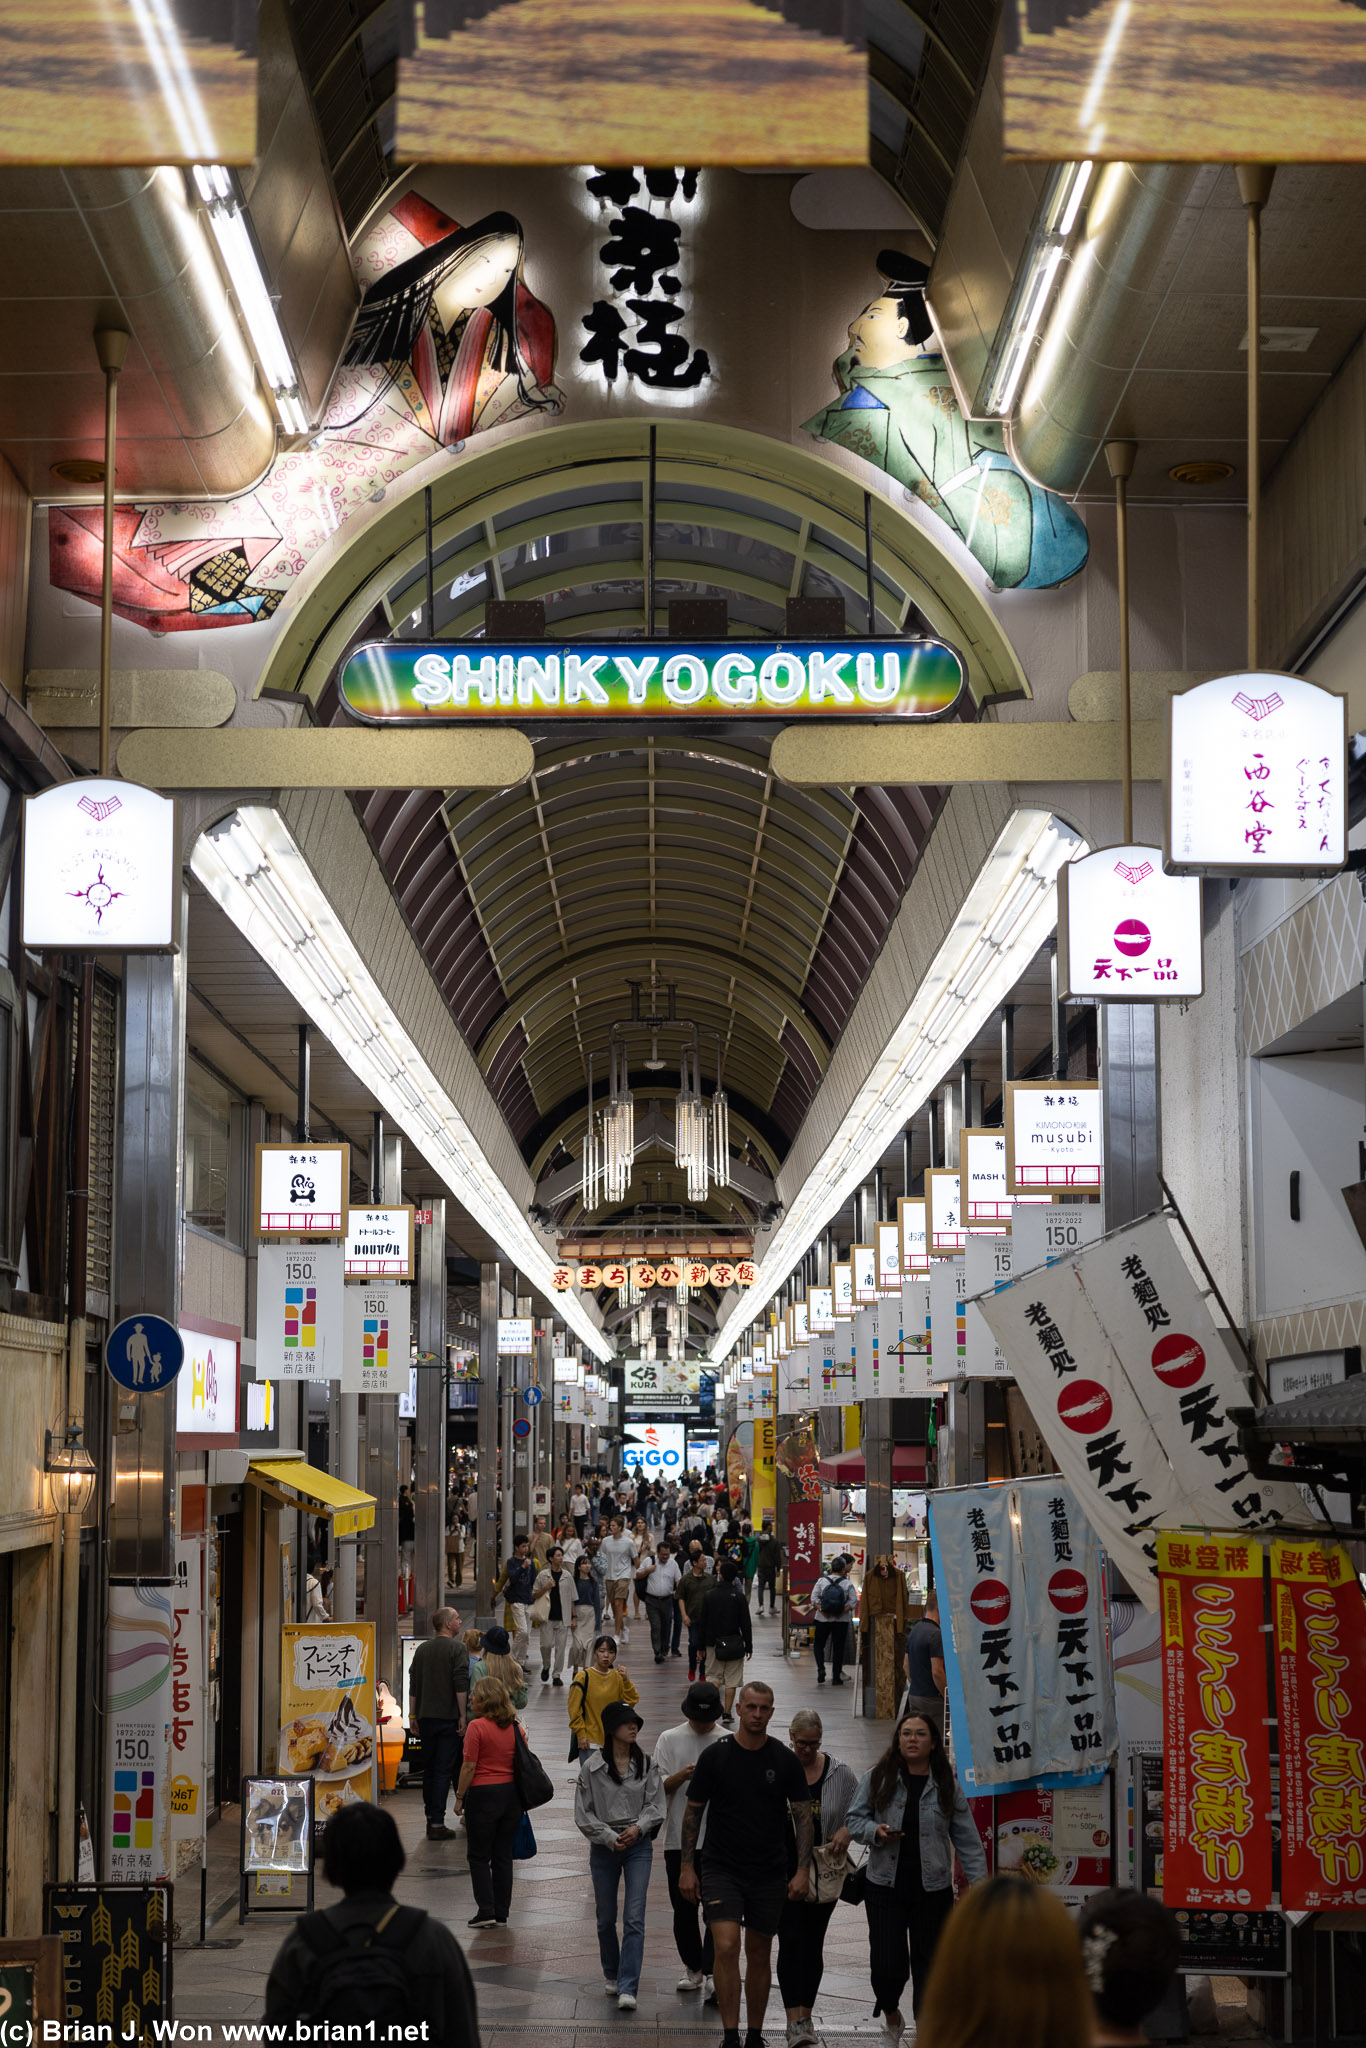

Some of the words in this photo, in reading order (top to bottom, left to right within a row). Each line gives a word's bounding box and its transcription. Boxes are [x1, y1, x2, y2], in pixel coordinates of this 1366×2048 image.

[412, 652, 902, 707] SHINKYOGOKU
[1244, 753, 1275, 854] 西谷堂
[1093, 958, 1179, 981] 天下一品
[1031, 1130, 1092, 1143] musubi
[291, 1173, 315, 1189] Rio
[972, 1173, 999, 1181] MASH
[359, 1228, 396, 1236] ドトールコーヒー
[354, 1243, 400, 1255] DOUTOR
[283, 1351, 316, 1362] 新京極
[283, 1364, 316, 1374] 商店街
[362, 1370, 388, 1379] 新京極
[630, 1366, 657, 1381] くら
[362, 1380, 388, 1389] 商店街
[630, 1381, 658, 1389] KURA
[623, 1449, 680, 1466] GiGO
[302, 1643, 355, 1663] フレンチ
[306, 1662, 352, 1681] トースト
[1057, 1617, 1103, 1752] 天下一品
[980, 1627, 1032, 1764] 天下一品
[116, 1729, 156, 1737] 1872-2022
[111, 1854, 152, 1868] 新京極
